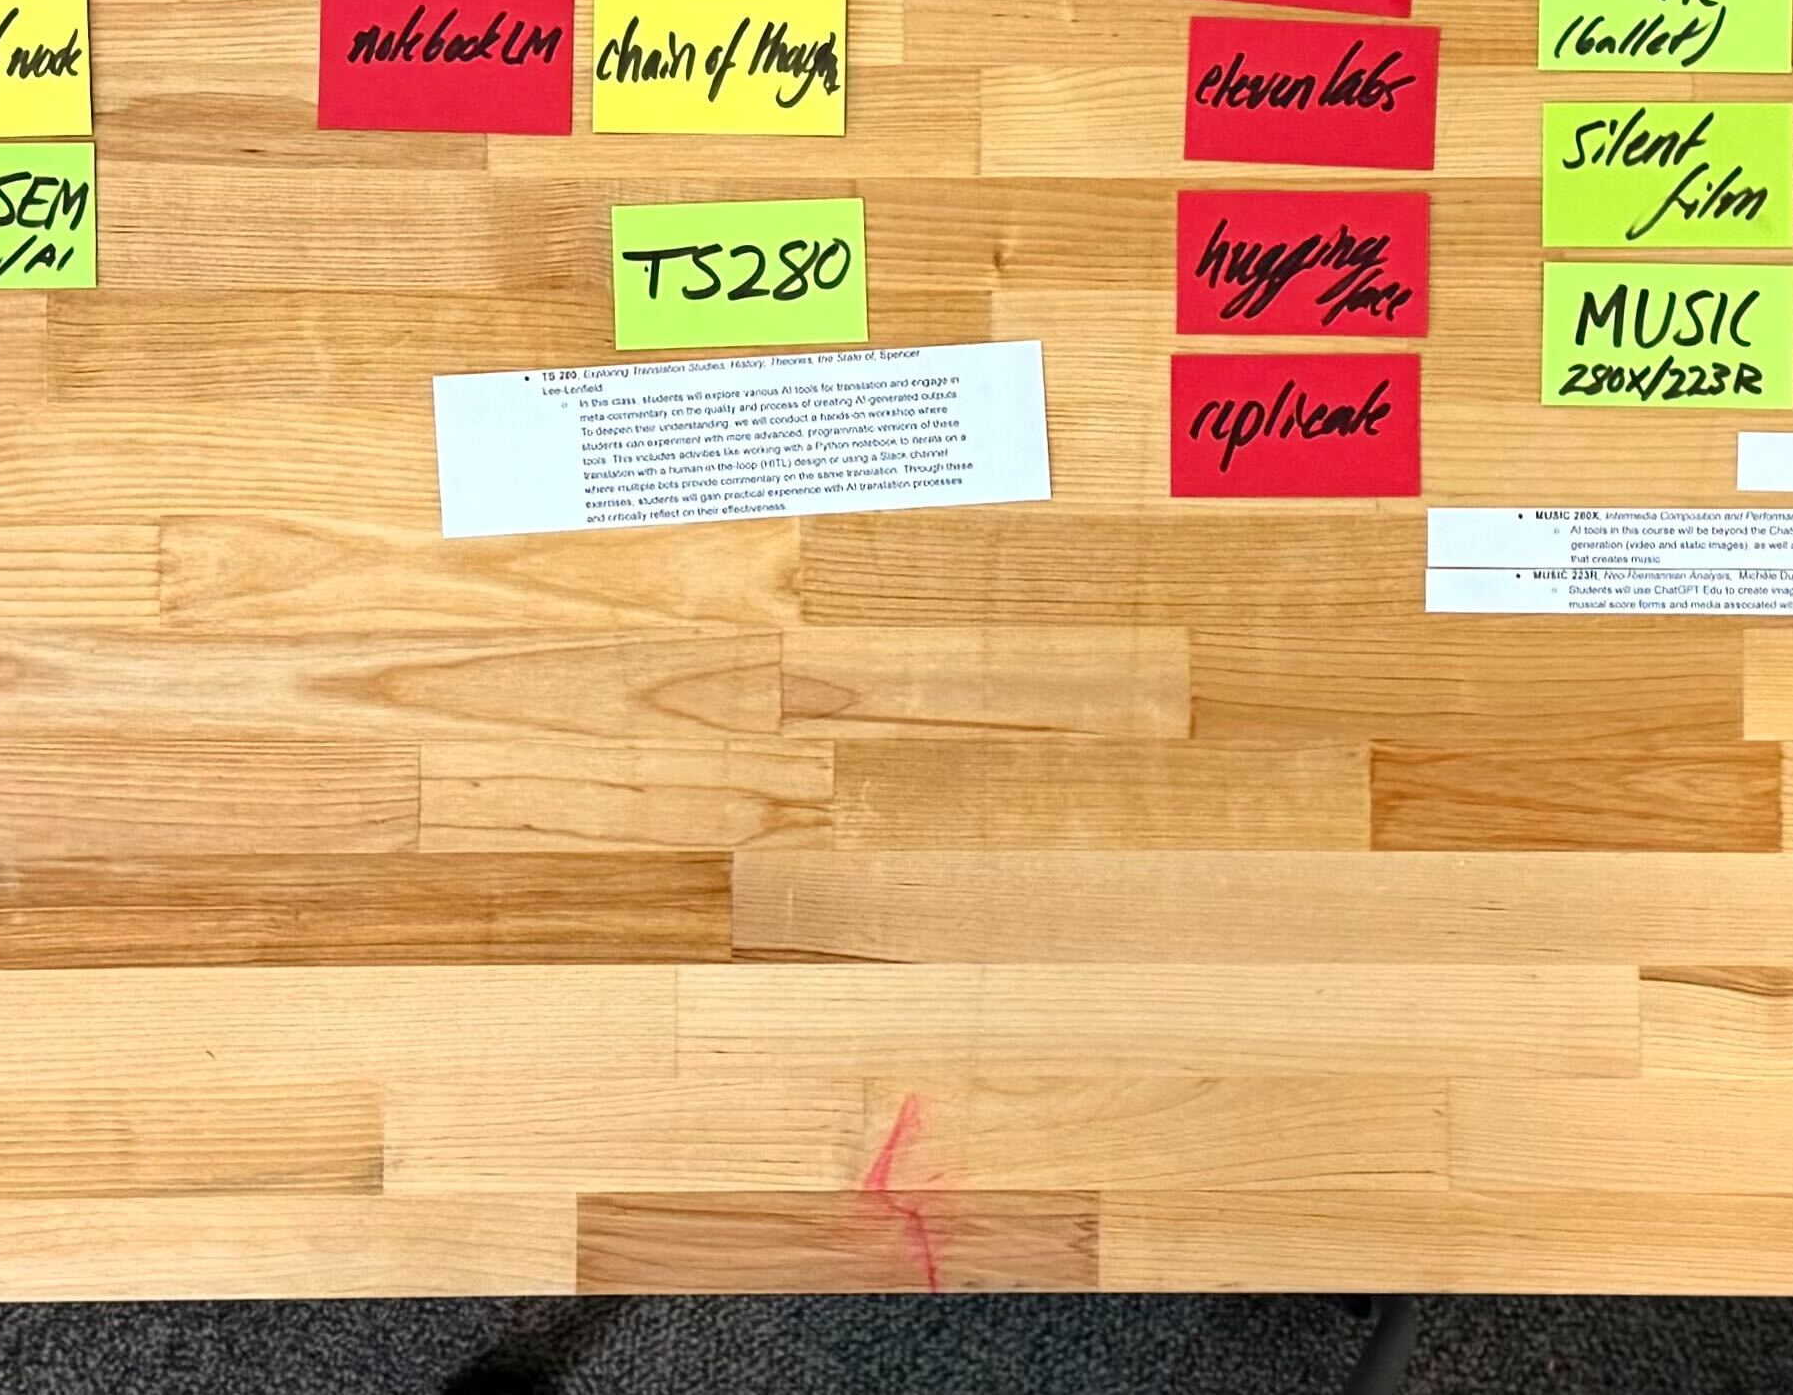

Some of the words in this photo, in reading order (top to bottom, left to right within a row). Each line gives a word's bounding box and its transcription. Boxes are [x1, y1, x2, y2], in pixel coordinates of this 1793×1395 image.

[597, 17, 695, 82] chain
[705, 17, 749, 102] of
[1624, 162, 1768, 241] film
[28, 242, 75, 273] AI
[1195, 218, 1389, 320] hugging
[1576, 285, 1756, 348] MUSIC
[1559, 356, 1762, 401] 280X/223R
[1191, 381, 1390, 470] replicate
